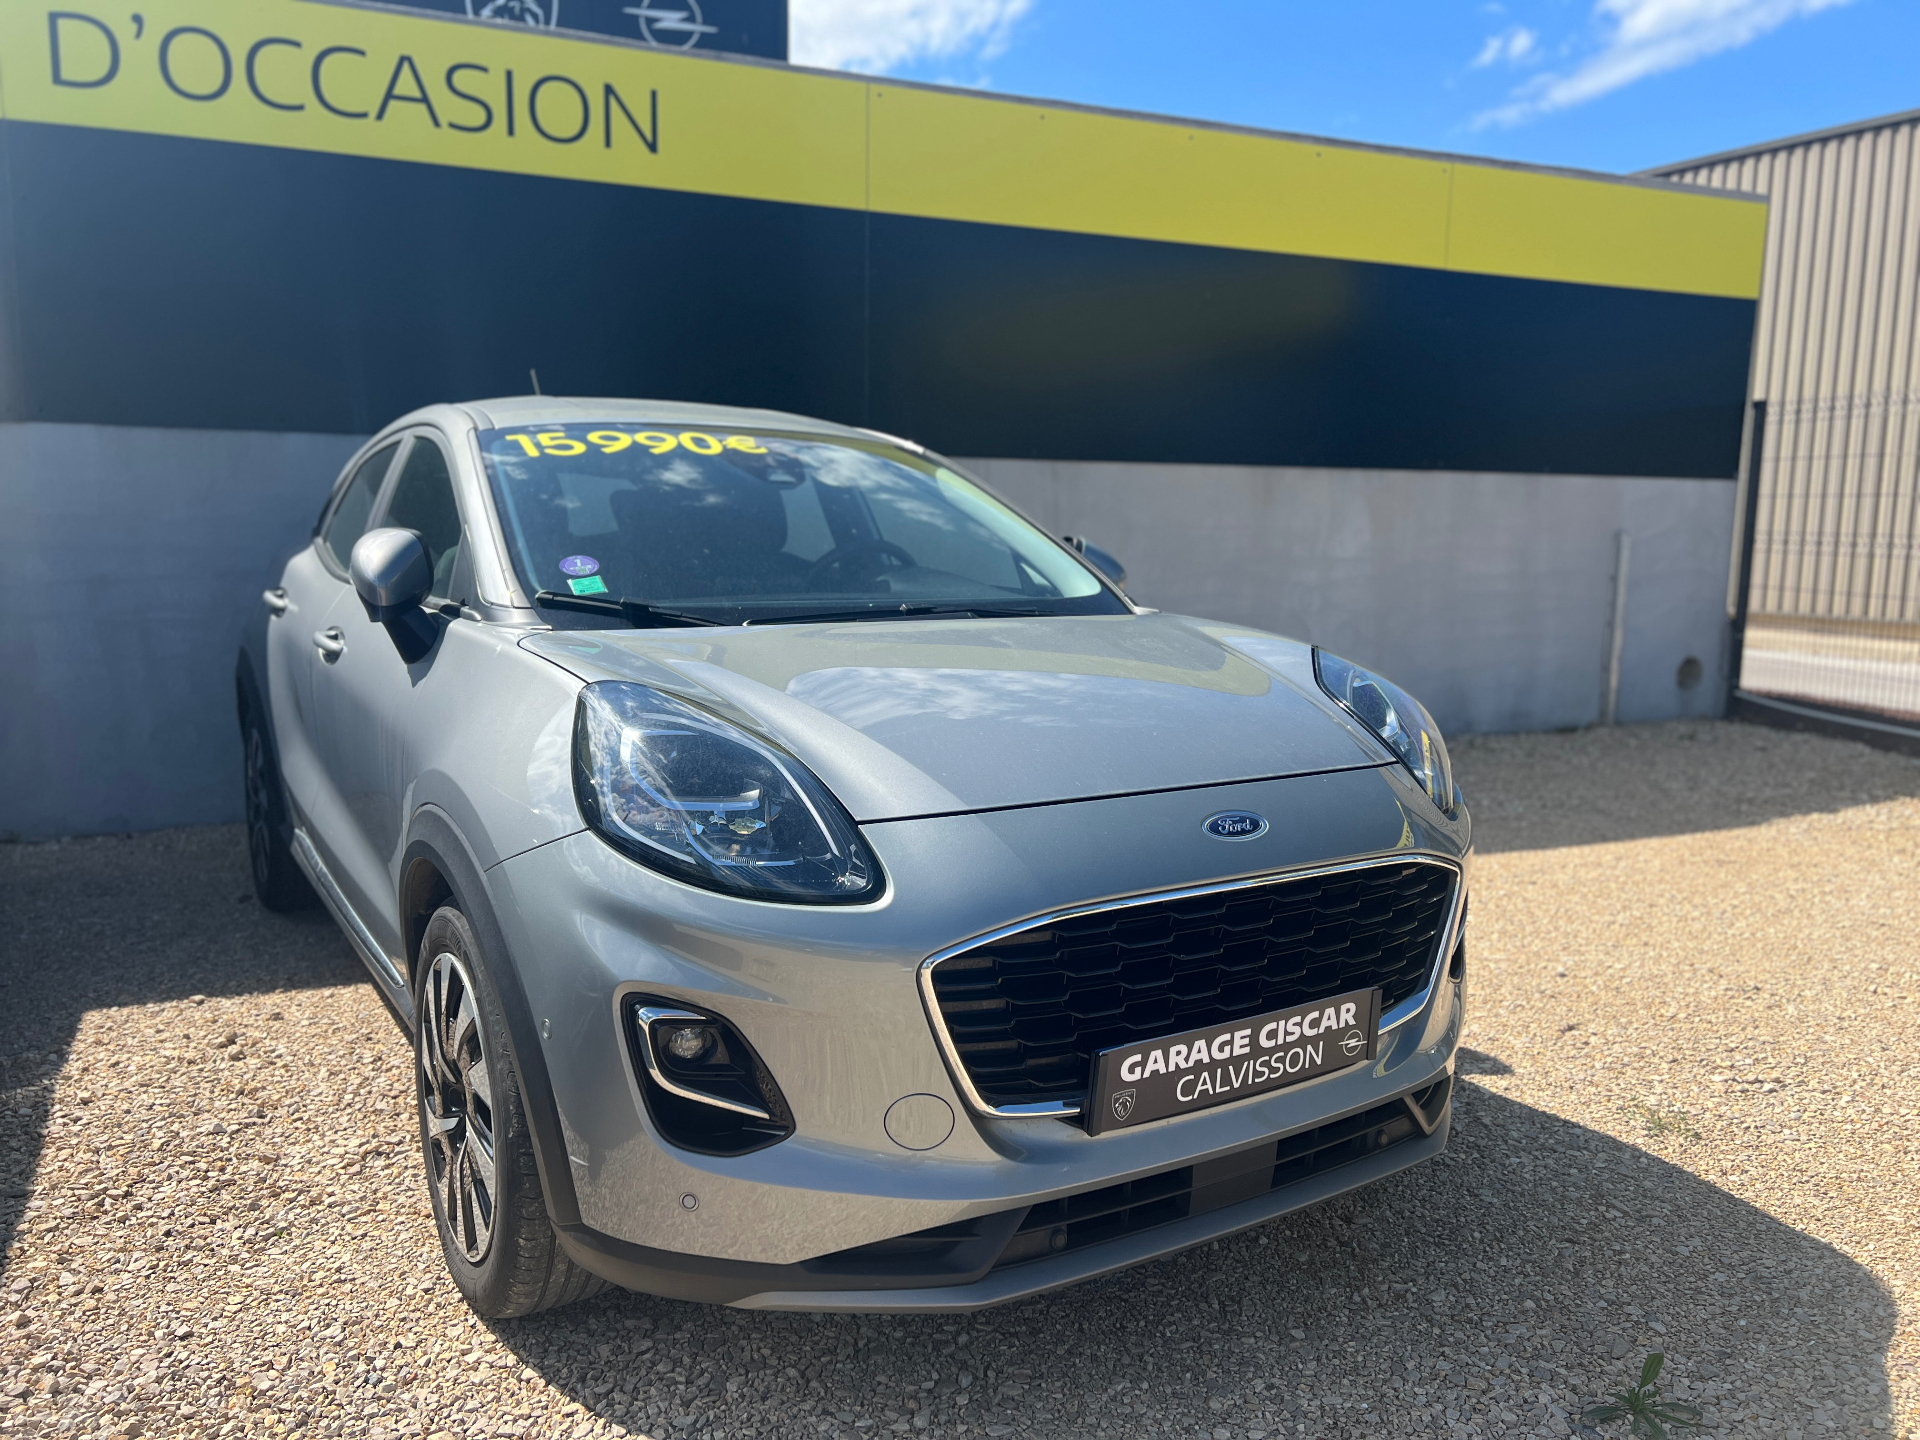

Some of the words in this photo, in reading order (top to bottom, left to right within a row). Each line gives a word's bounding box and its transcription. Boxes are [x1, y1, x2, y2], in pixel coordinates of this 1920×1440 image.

[1218, 816, 1254, 835] Ford
[1120, 1028, 1252, 1082] GARAGE
[1258, 1002, 1357, 1048] CISCAR
[1175, 1041, 1324, 1102] CALVISSON
